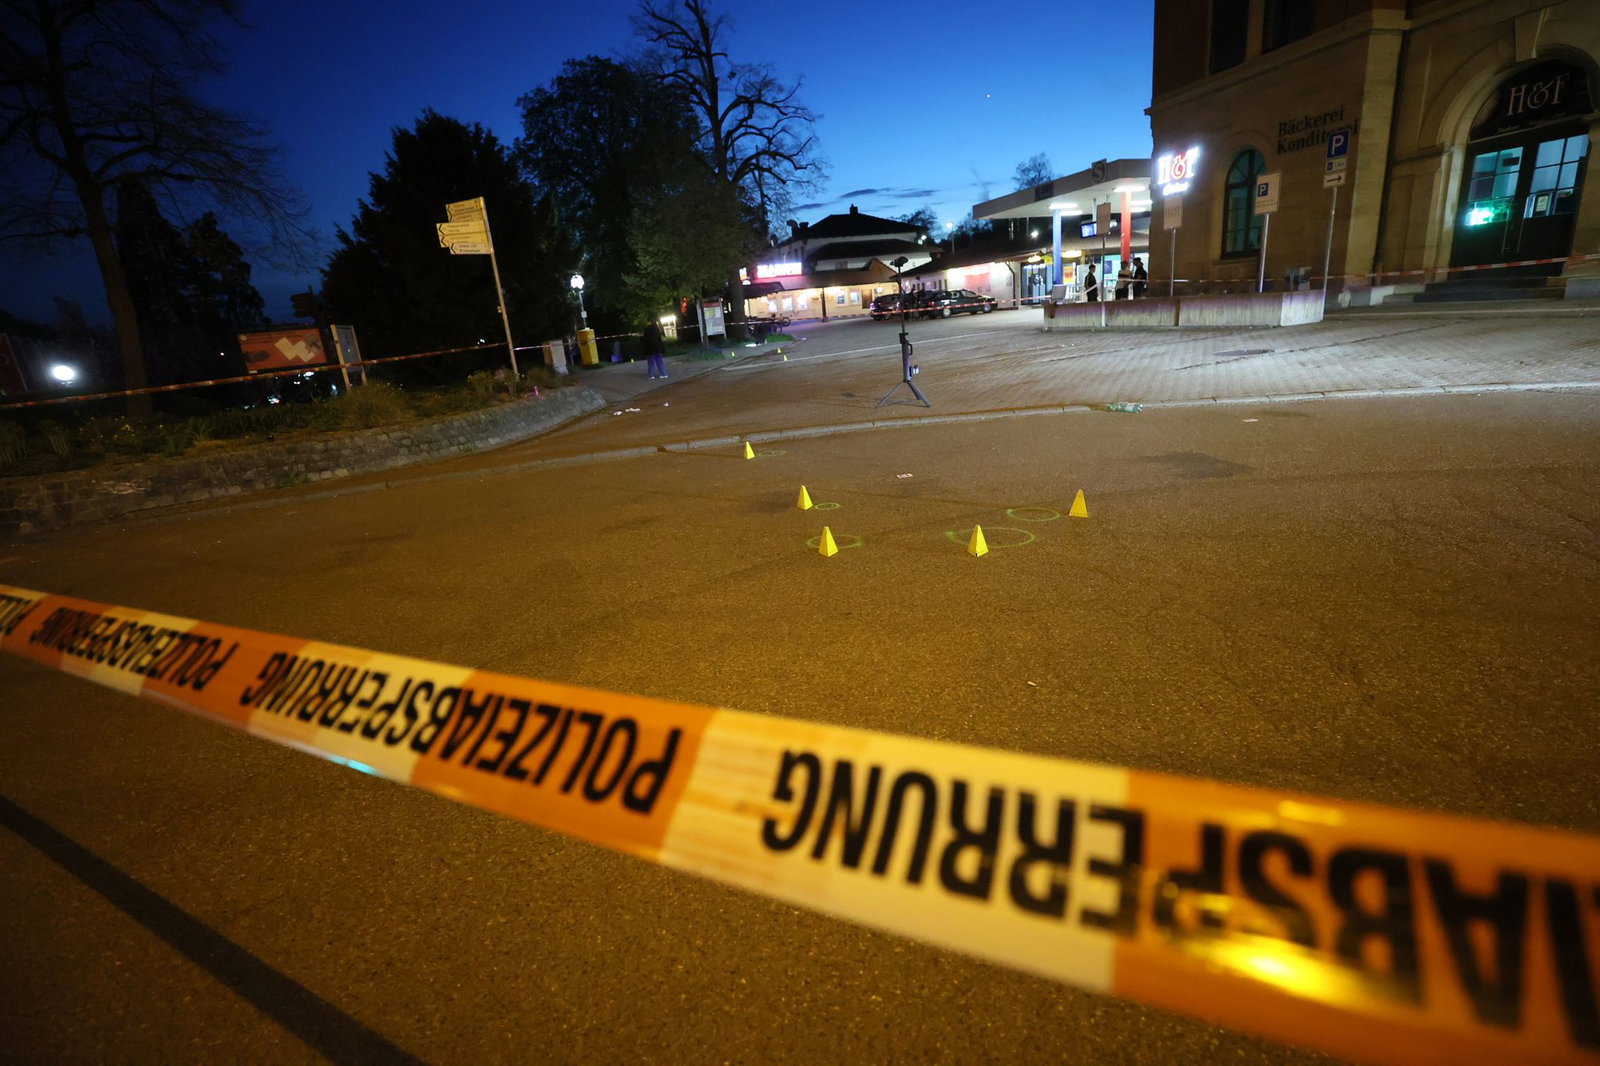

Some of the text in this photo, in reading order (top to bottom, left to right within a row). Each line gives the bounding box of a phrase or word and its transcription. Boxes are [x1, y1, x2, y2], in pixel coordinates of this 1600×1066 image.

[1506, 72, 1570, 116] H&F
[1279, 103, 1345, 138] Bäckerei
[1157, 146, 1199, 185] H&F
[240, 651, 684, 815] POLIZEIABSPERRUNG
[760, 748, 1600, 1053] IABSPERRUNG
